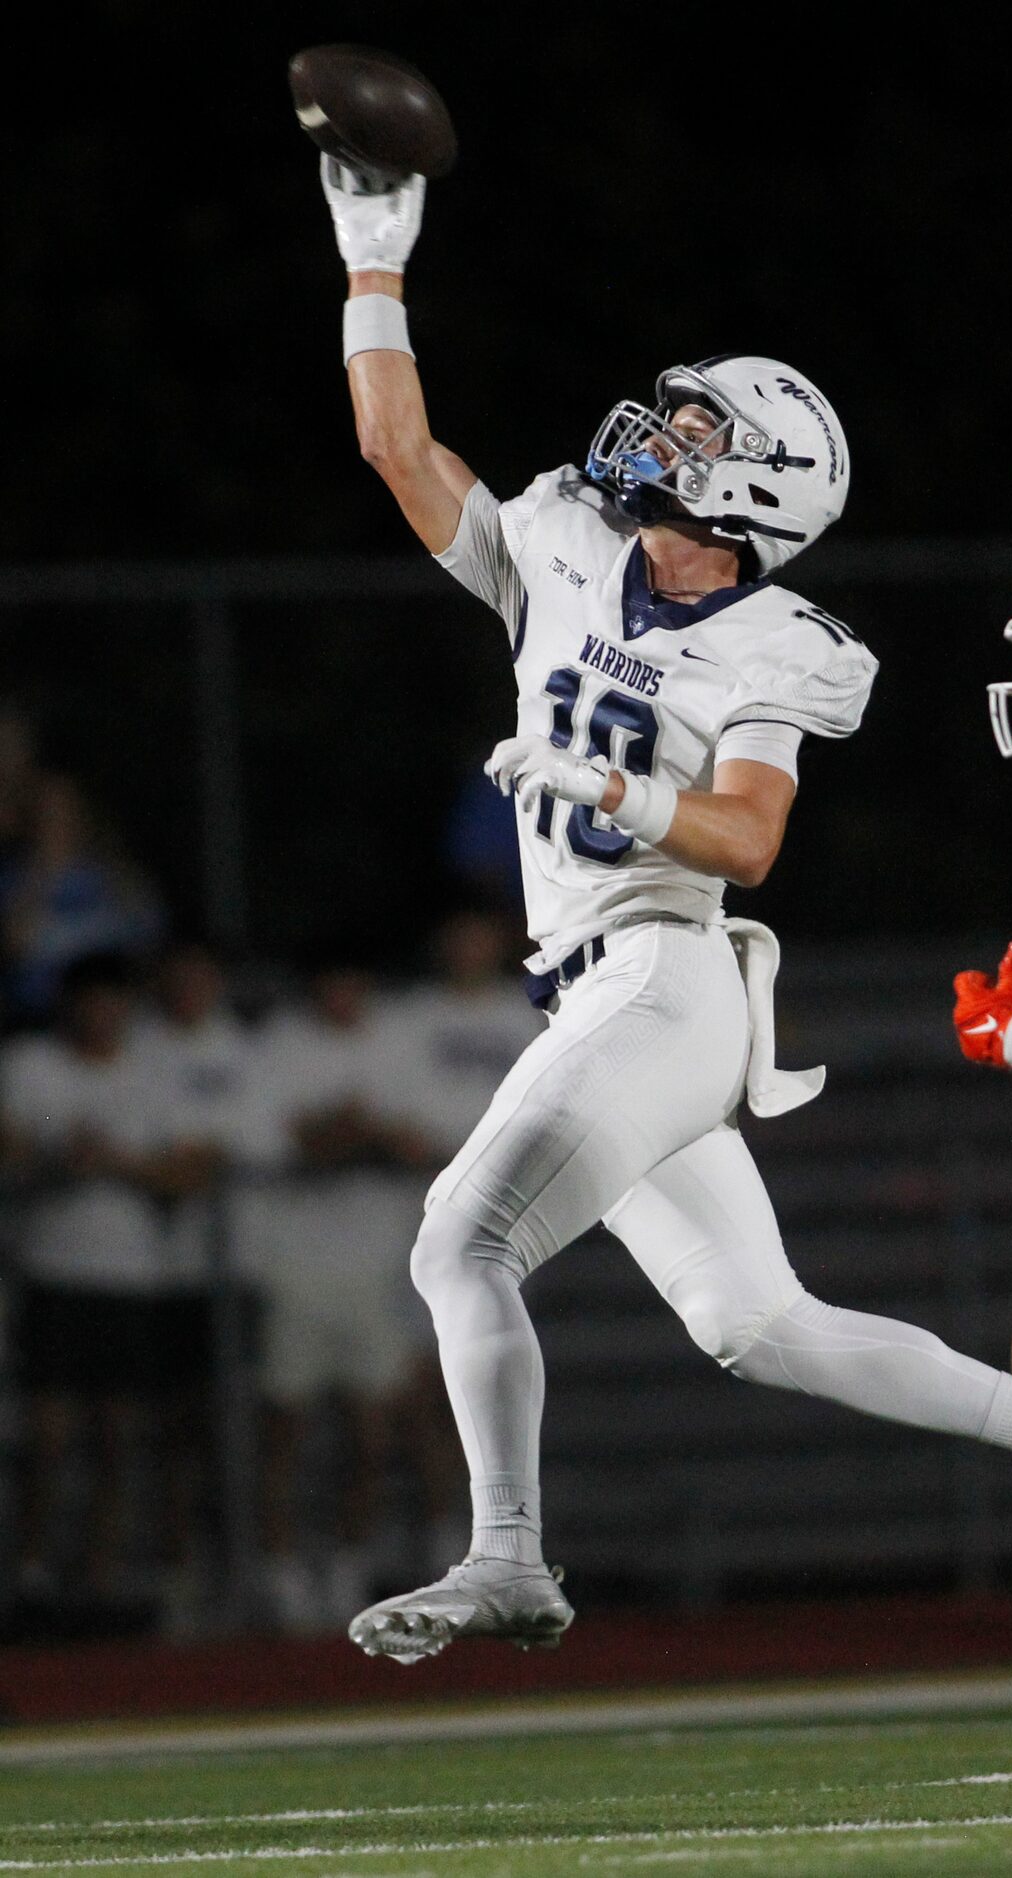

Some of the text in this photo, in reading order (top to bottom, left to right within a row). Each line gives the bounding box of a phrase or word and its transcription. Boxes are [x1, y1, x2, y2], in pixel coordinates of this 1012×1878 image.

[548, 555, 589, 590] FOR HIM
[579, 633, 665, 697] WARRIORS
